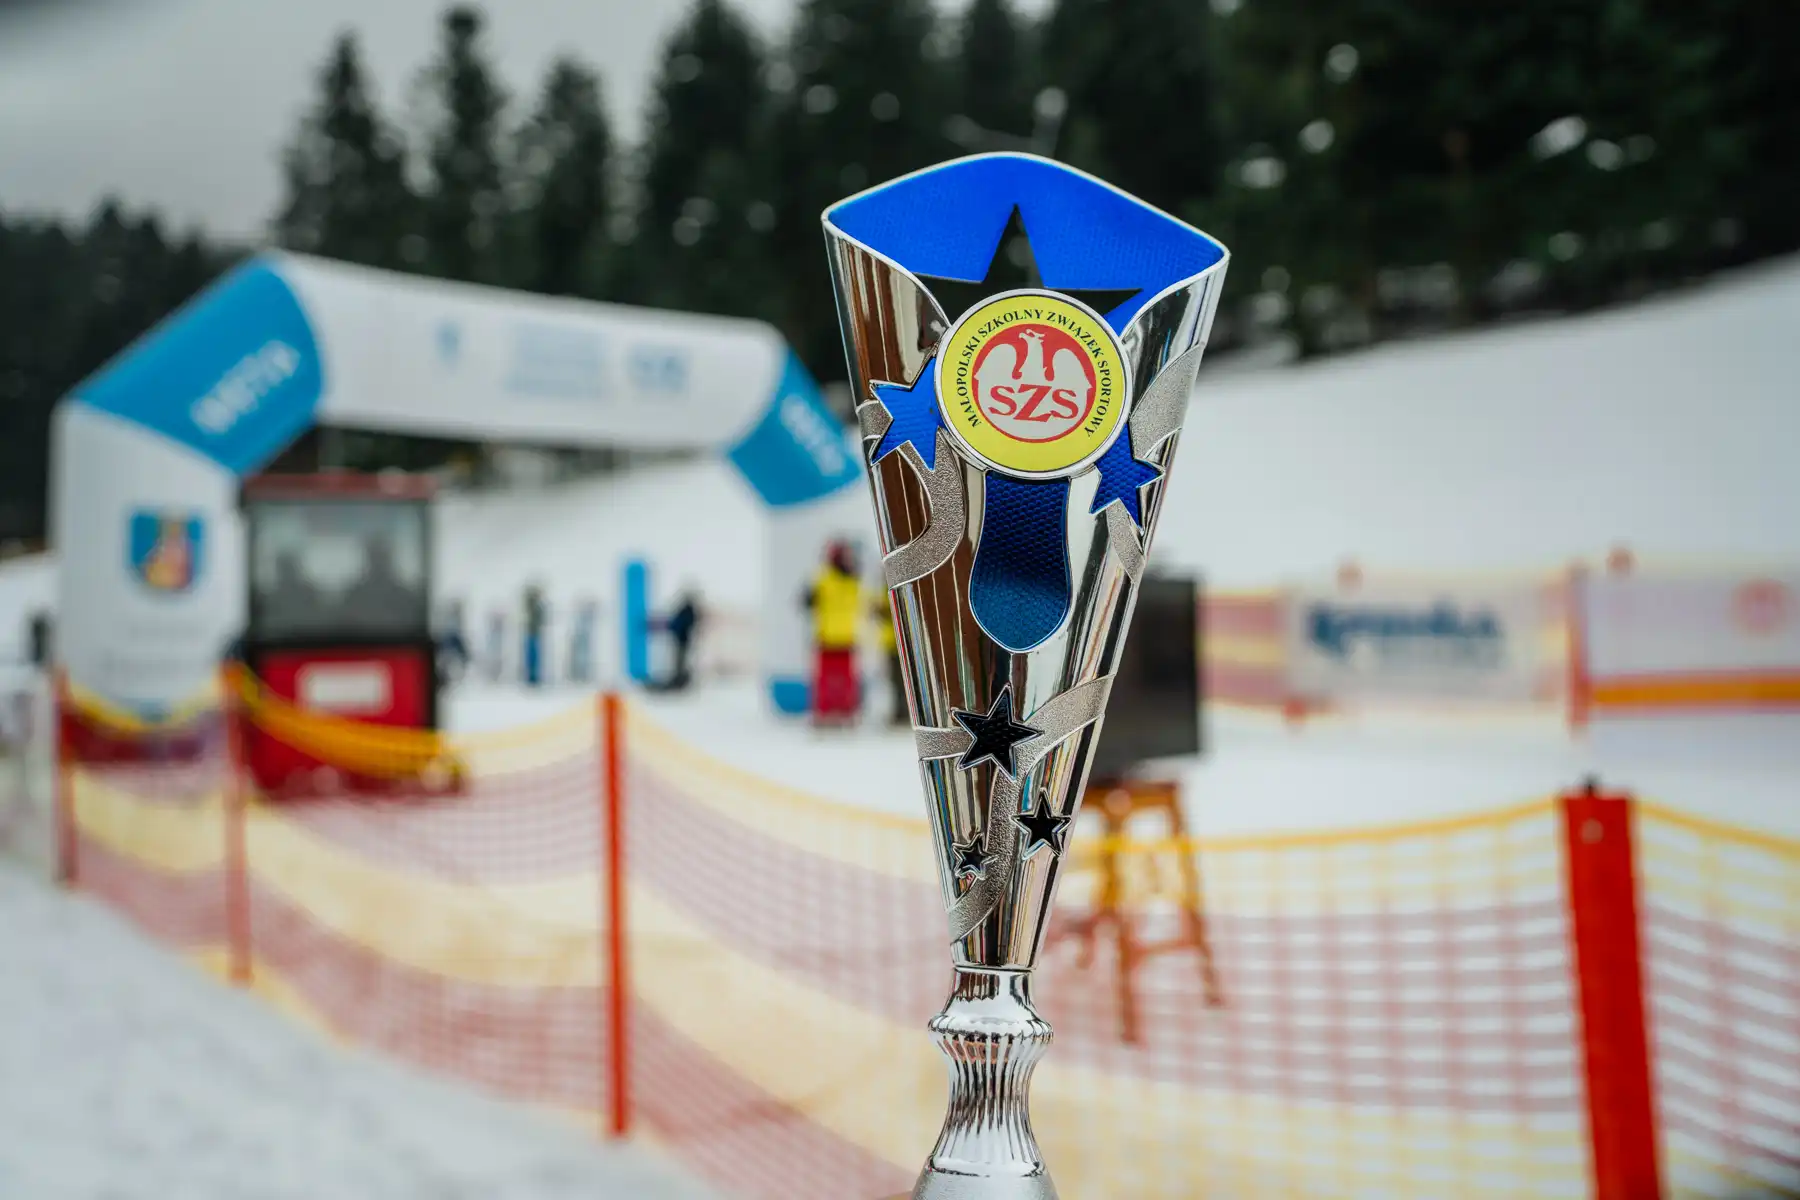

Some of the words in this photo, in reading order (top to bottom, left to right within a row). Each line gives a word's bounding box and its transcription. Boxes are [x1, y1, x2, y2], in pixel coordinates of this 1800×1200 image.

[978, 309, 1044, 338] SZKOLNY
[1046, 311, 1104, 358] ZWIĄZEK
[1084, 360, 1112, 438] SPORTOWY
[988, 384, 1079, 423] SZS
